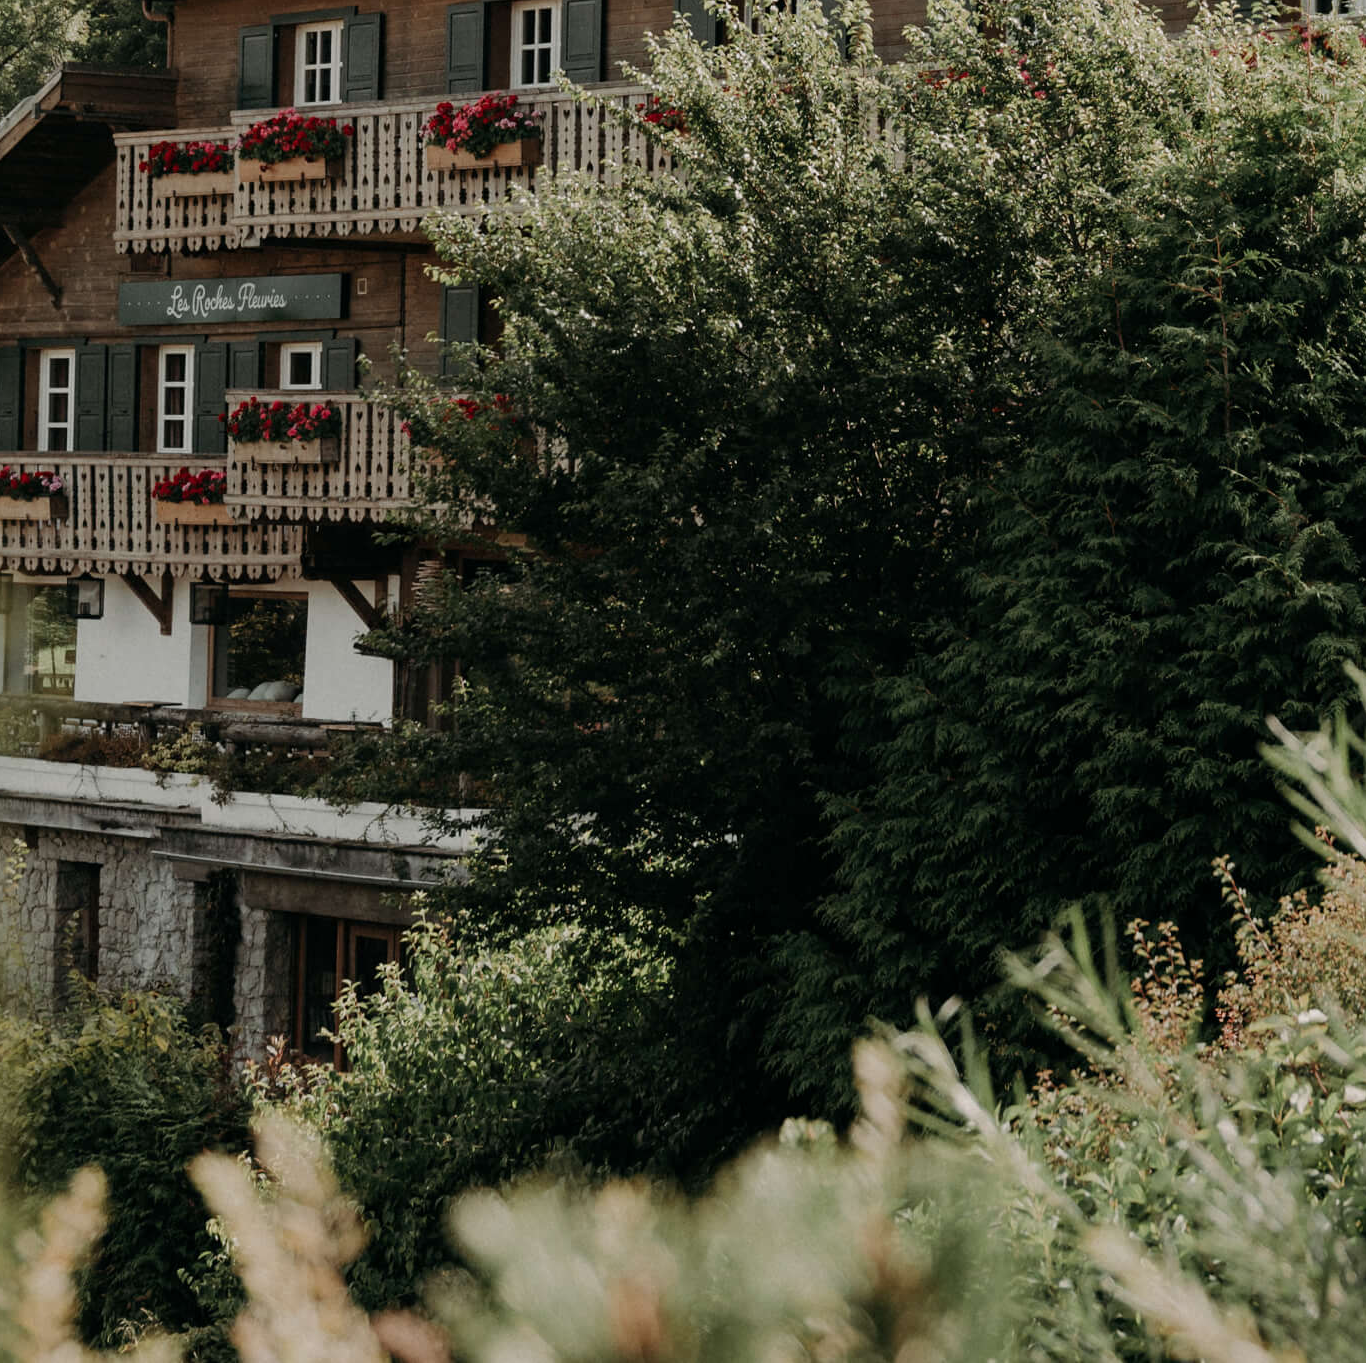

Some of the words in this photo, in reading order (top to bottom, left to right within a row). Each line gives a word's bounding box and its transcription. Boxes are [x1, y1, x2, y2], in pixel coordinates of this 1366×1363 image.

[166, 285, 190, 318] Les
[192, 284, 235, 317] Roches
[237, 282, 288, 311] Fleuries
